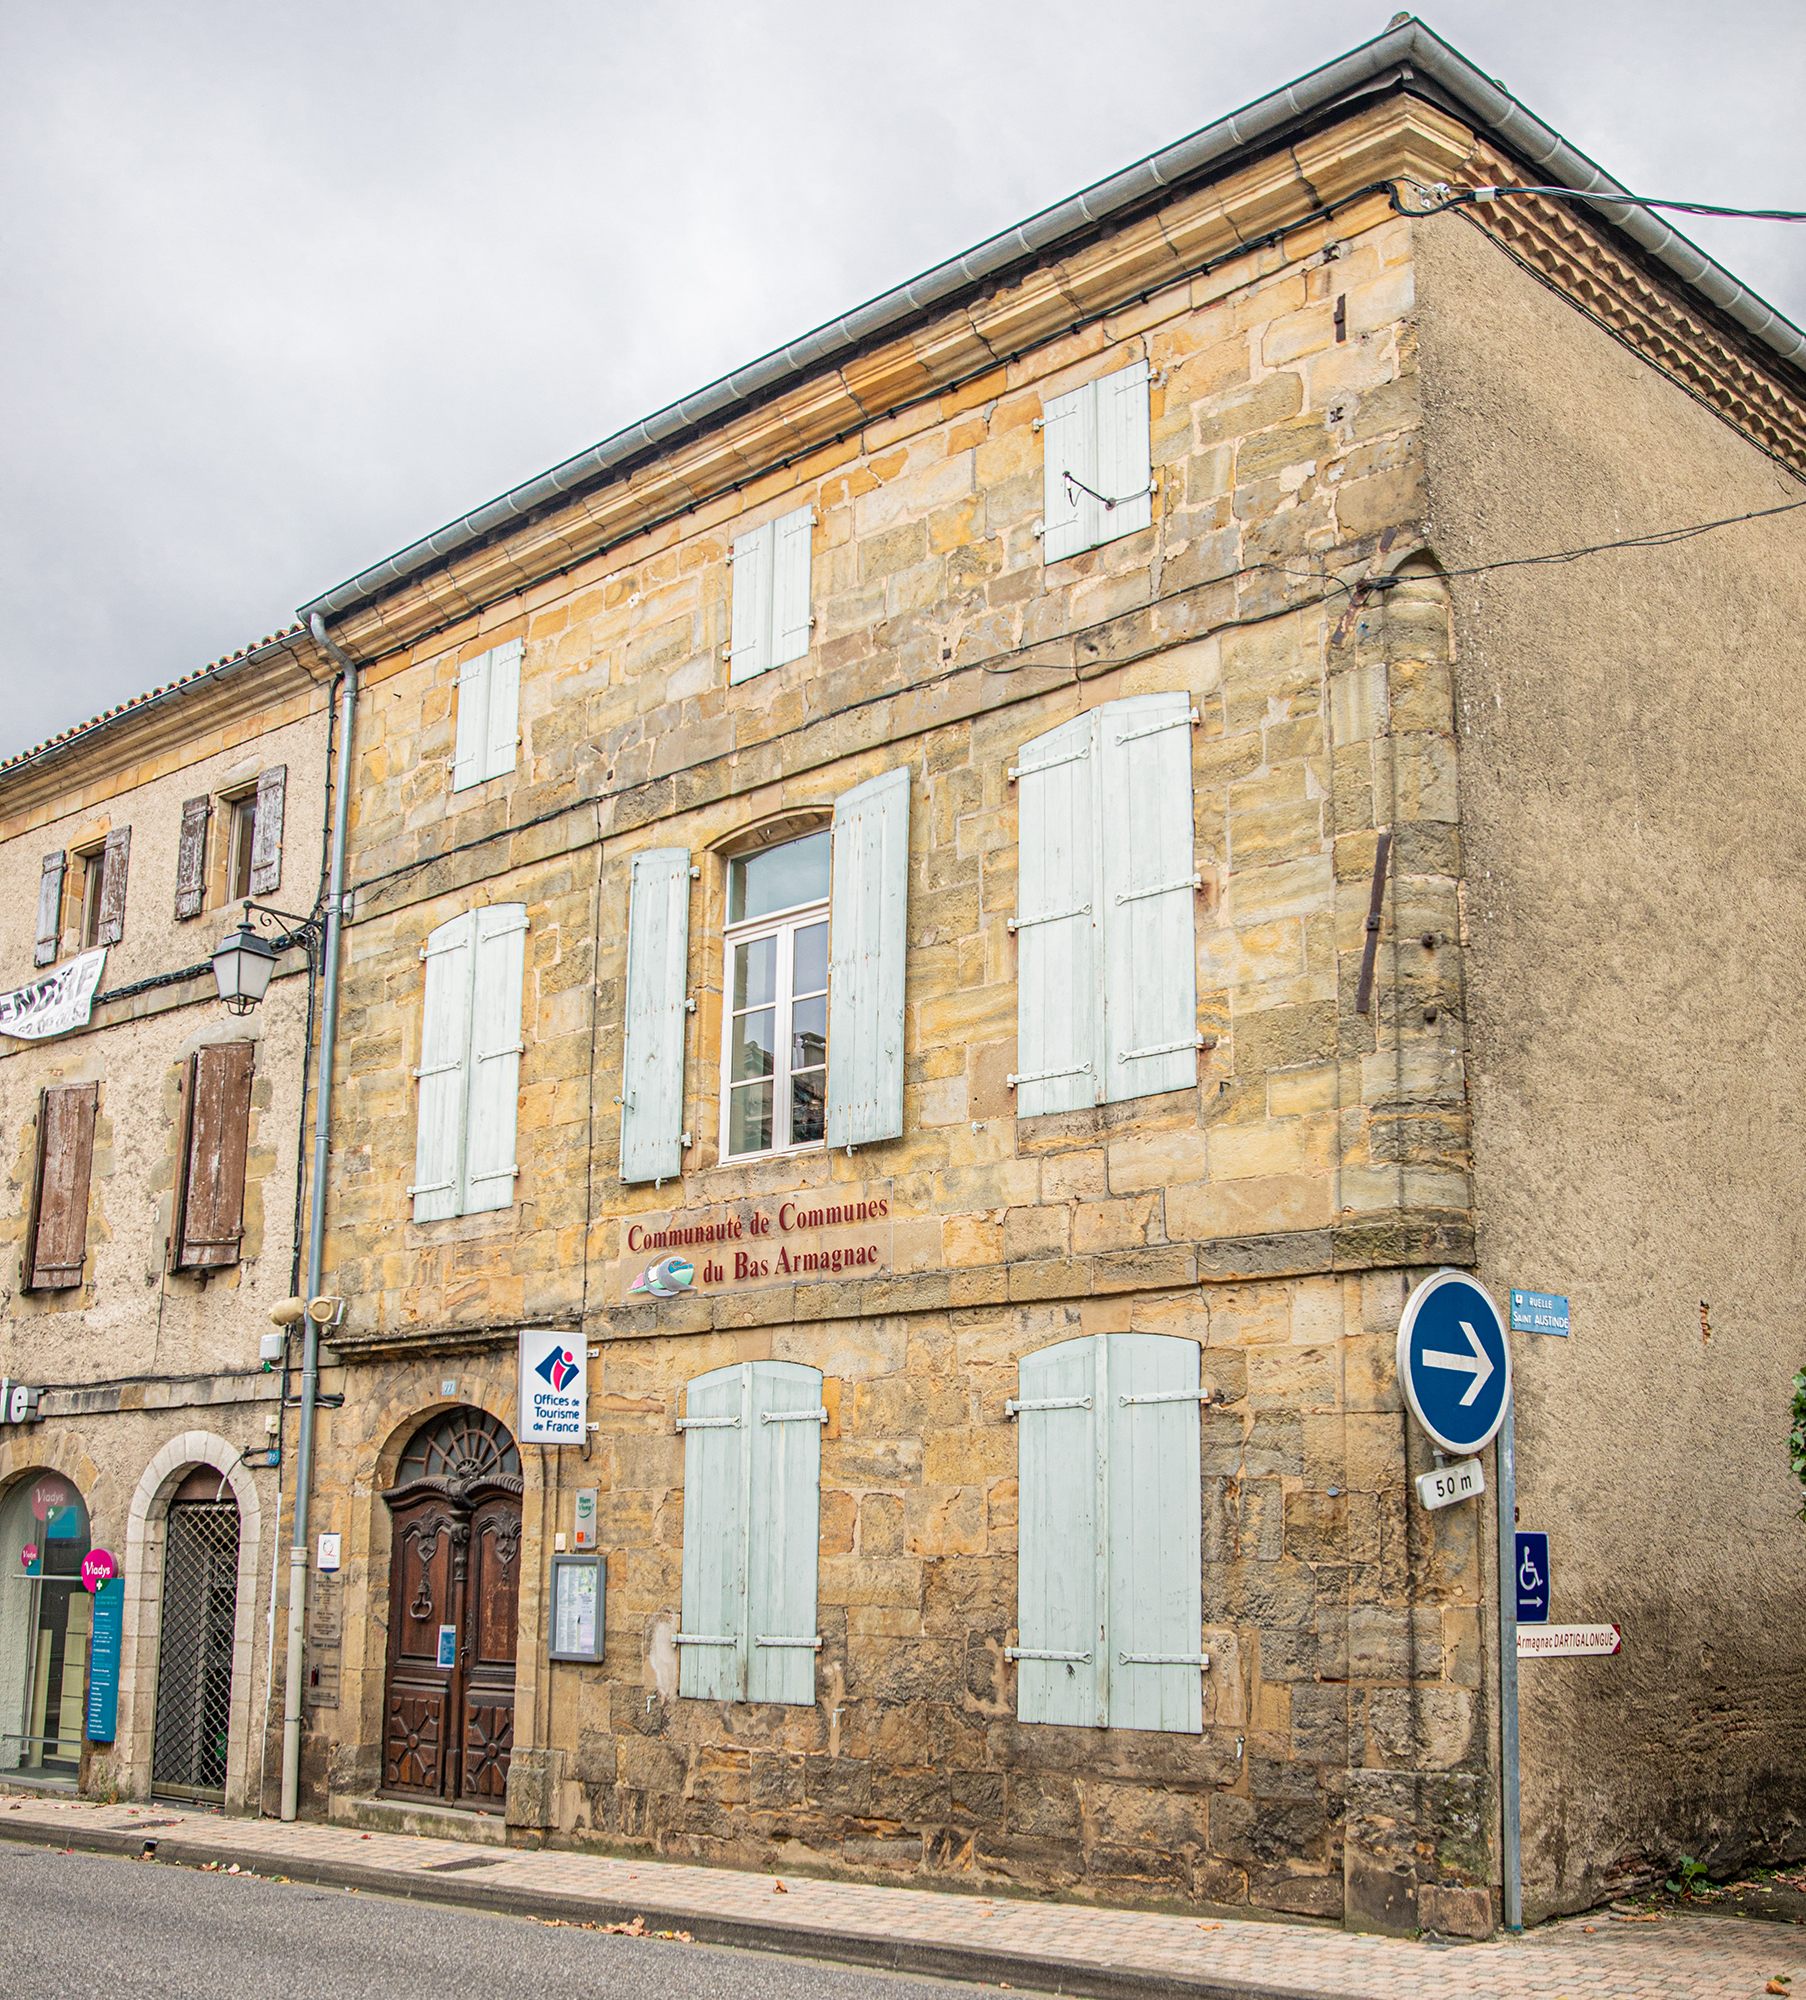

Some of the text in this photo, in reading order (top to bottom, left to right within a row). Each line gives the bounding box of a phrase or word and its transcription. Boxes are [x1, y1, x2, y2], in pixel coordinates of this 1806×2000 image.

[628, 1199, 888, 1251] Communauté de Communes
[703, 1246, 878, 1283] du Bas Armagnac
[1529, 1297, 1552, 1309] RUELLE
[1534, 1314, 1569, 1329] AUSTINDE
[534, 1394, 580, 1407] Offices de
[534, 1406, 580, 1419] Tourisme
[533, 1420, 579, 1433] de France
[1436, 1475, 1472, 1498] 50 m
[36, 1488, 64, 1505] Viadys
[85, 1561, 111, 1578] Viadys
[1517, 1632, 1614, 1652] Armagnac DARTIGALONGUE
